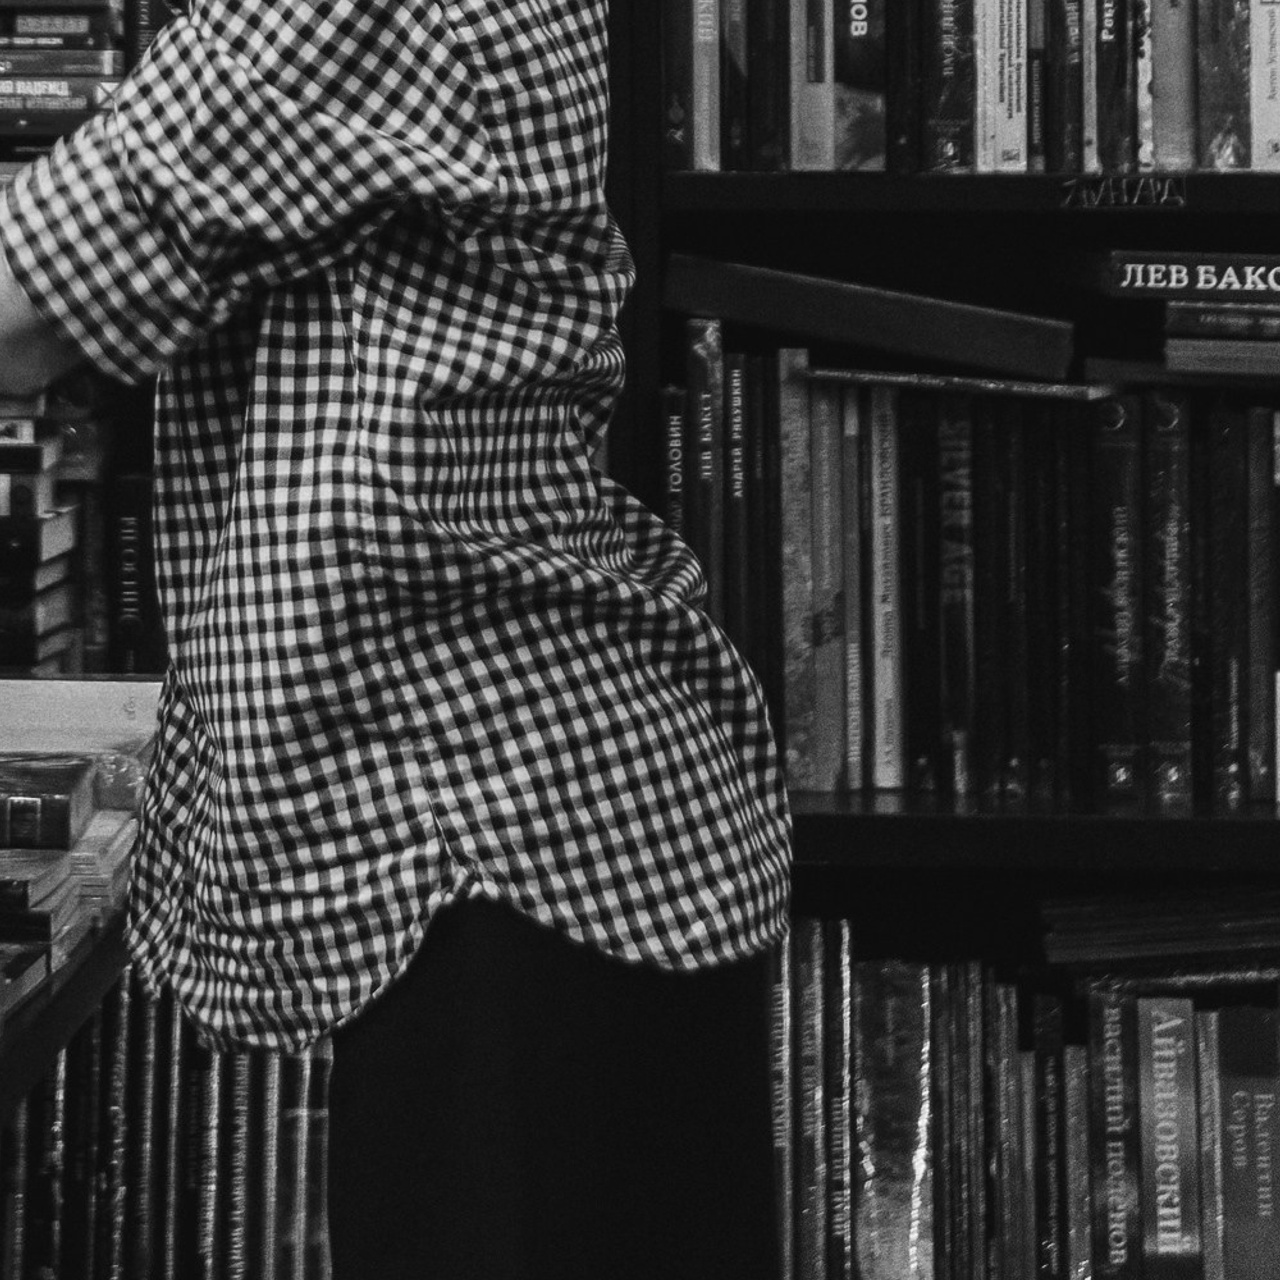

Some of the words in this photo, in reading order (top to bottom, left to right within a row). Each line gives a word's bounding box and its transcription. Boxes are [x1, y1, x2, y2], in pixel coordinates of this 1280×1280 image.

[1120, 263, 1190, 289] ЛЕВ
[668, 414, 683, 493] ГОЛОВИН
[939, 419, 974, 527] SILVER
[939, 540, 974, 604] AGE
[1226, 1089, 1250, 1170] Серов
[1254, 1091, 1276, 1218] Валентин
